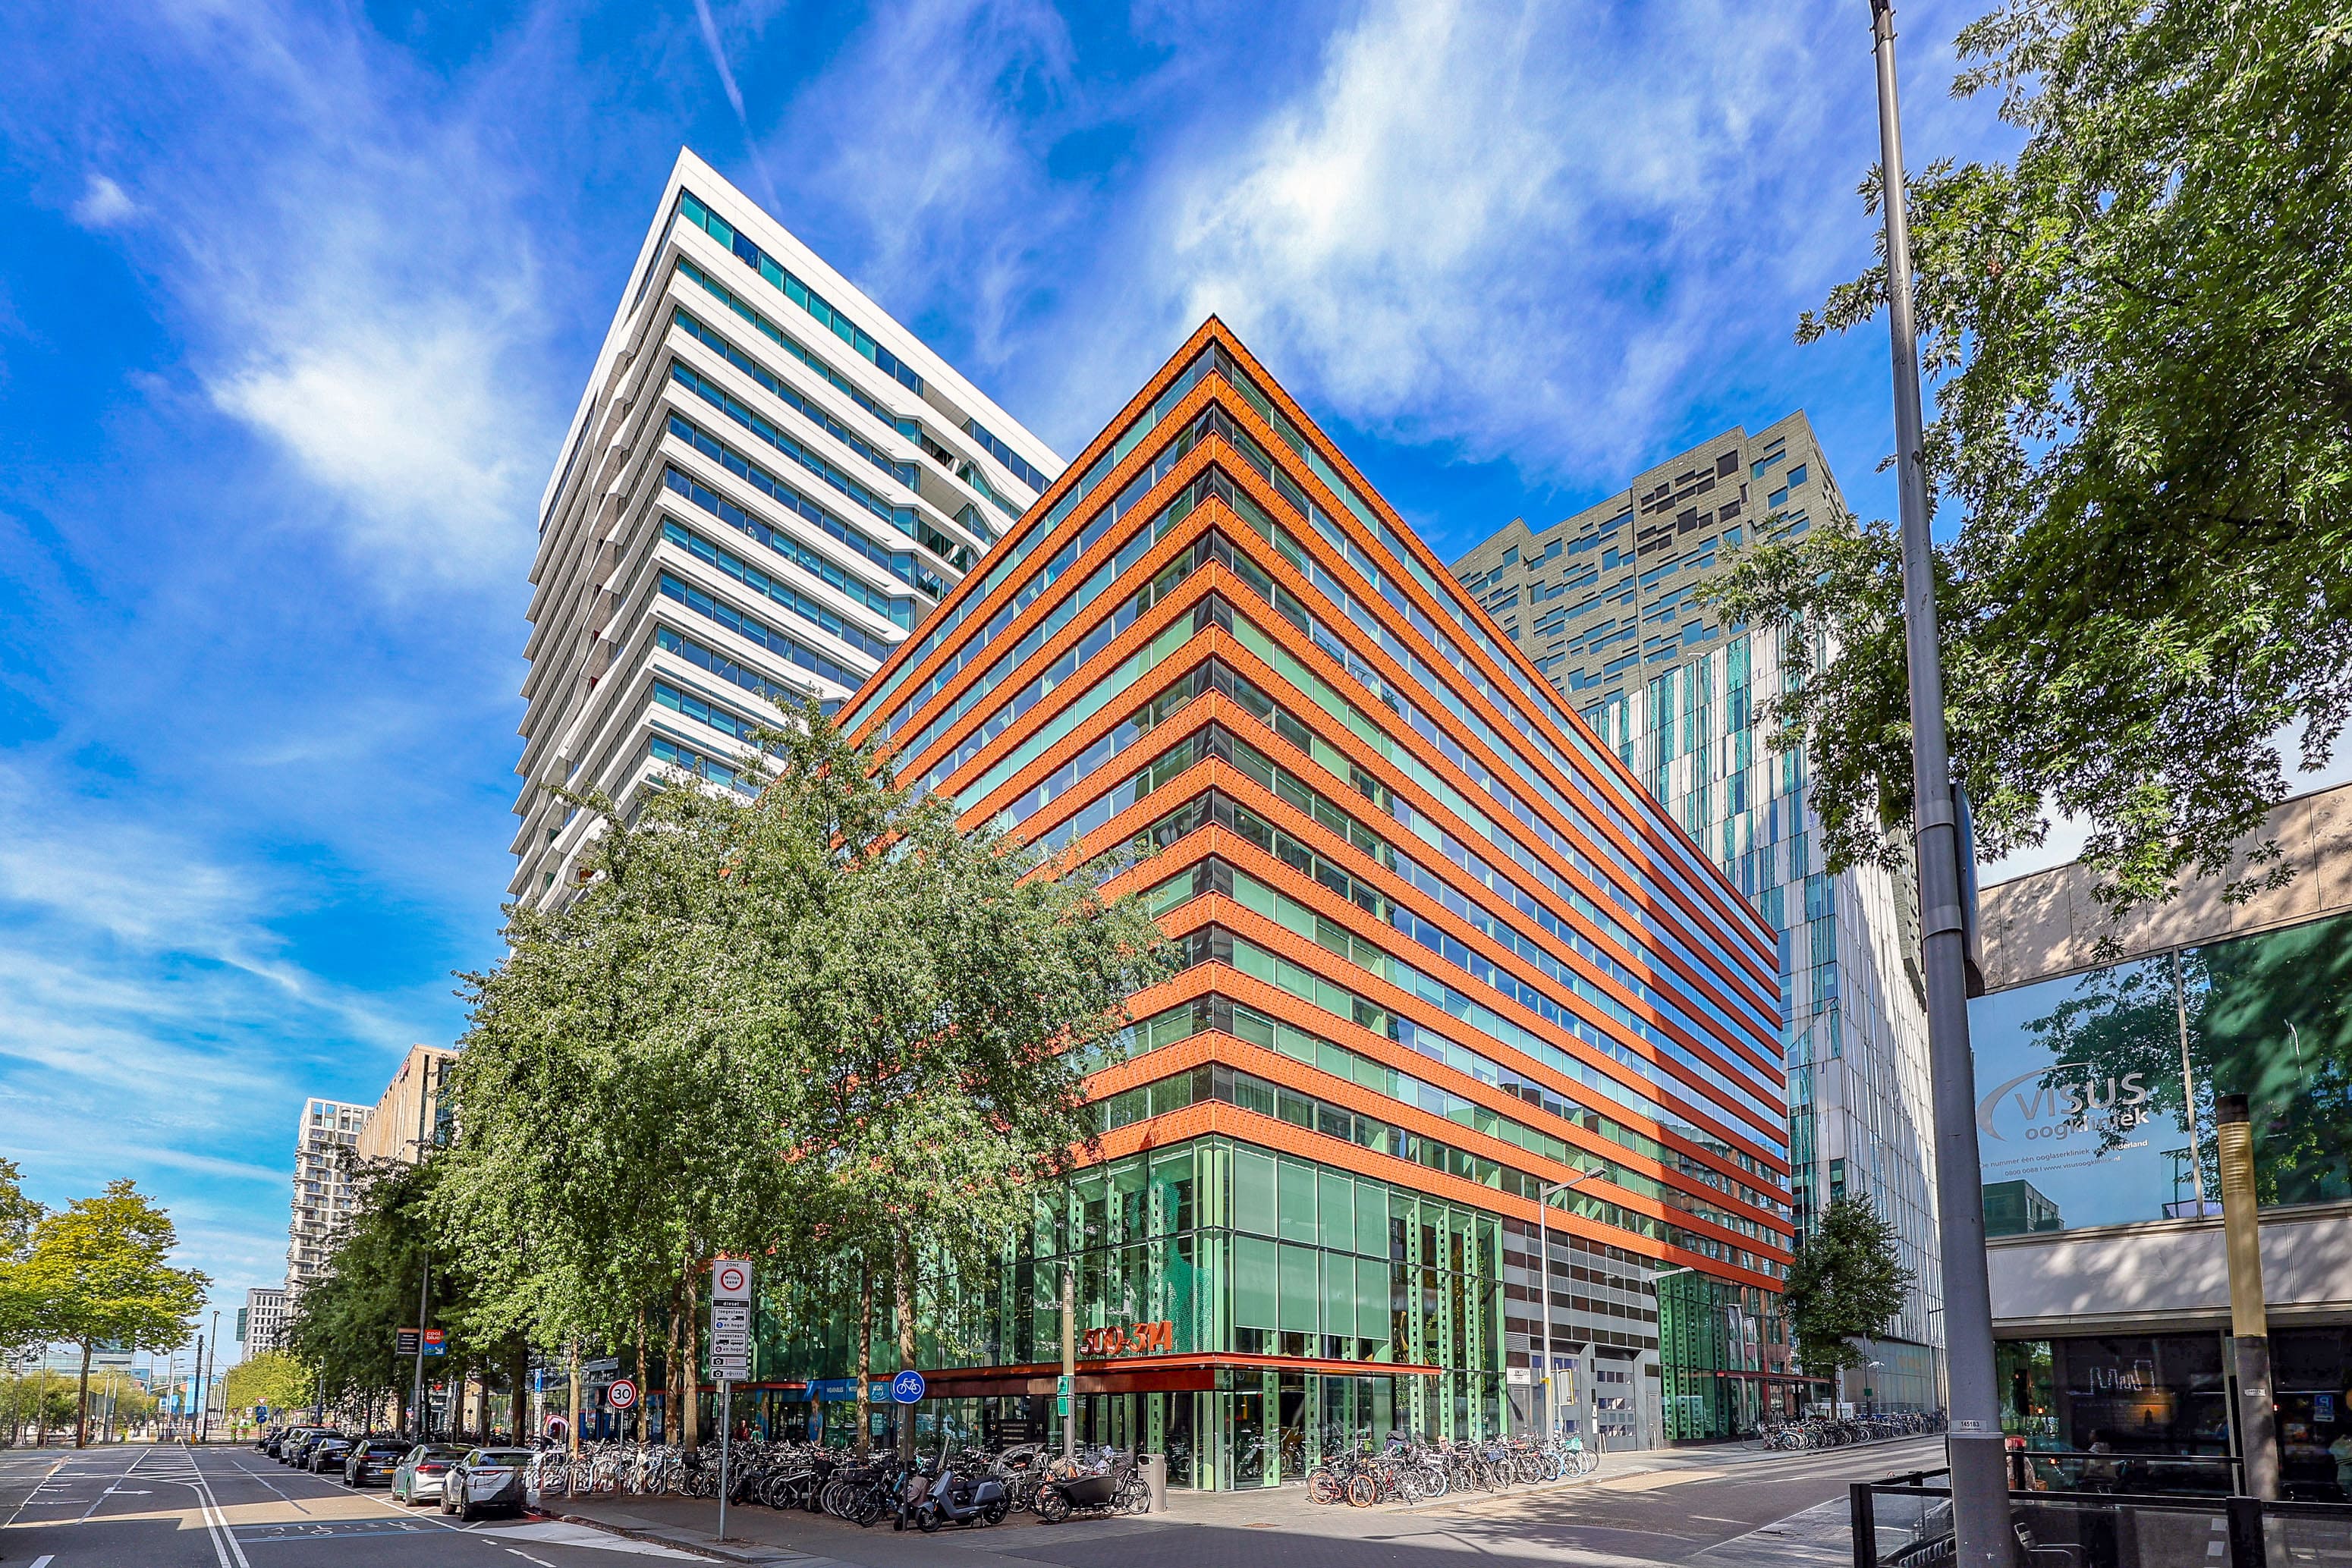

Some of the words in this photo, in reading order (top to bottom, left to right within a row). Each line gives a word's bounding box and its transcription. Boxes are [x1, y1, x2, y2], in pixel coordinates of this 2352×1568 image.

[2014, 1072, 2147, 1120] VISUS
[2025, 1108, 2149, 1140] oogkliniek
[1990, 1158, 2020, 1167] nummer
[2036, 1148, 2090, 1162] ooglaserkliniek
[2044, 1155, 2121, 1171] www.visusoogkliniek.nl
[1079, 1320, 1172, 1356] 300-314
[613, 1388, 631, 1400] 30
